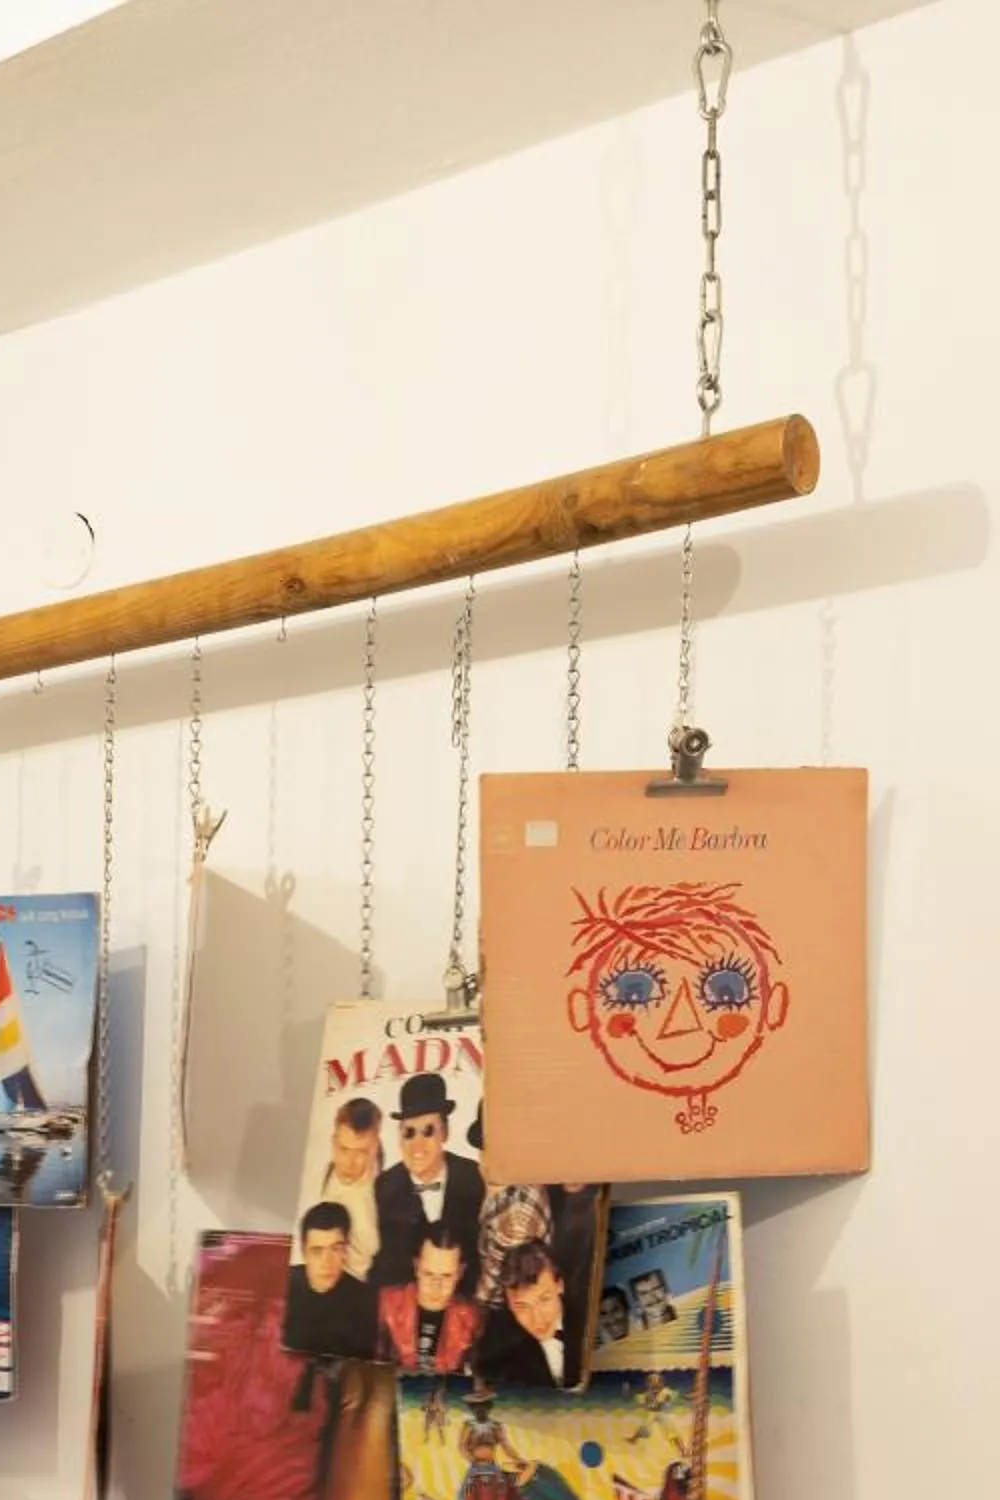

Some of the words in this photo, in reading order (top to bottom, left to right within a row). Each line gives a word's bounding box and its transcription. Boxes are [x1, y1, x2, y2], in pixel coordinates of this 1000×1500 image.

[590, 826, 650, 851] Color
[653, 826, 685, 851] Me
[324, 1036, 484, 1096] MADN
